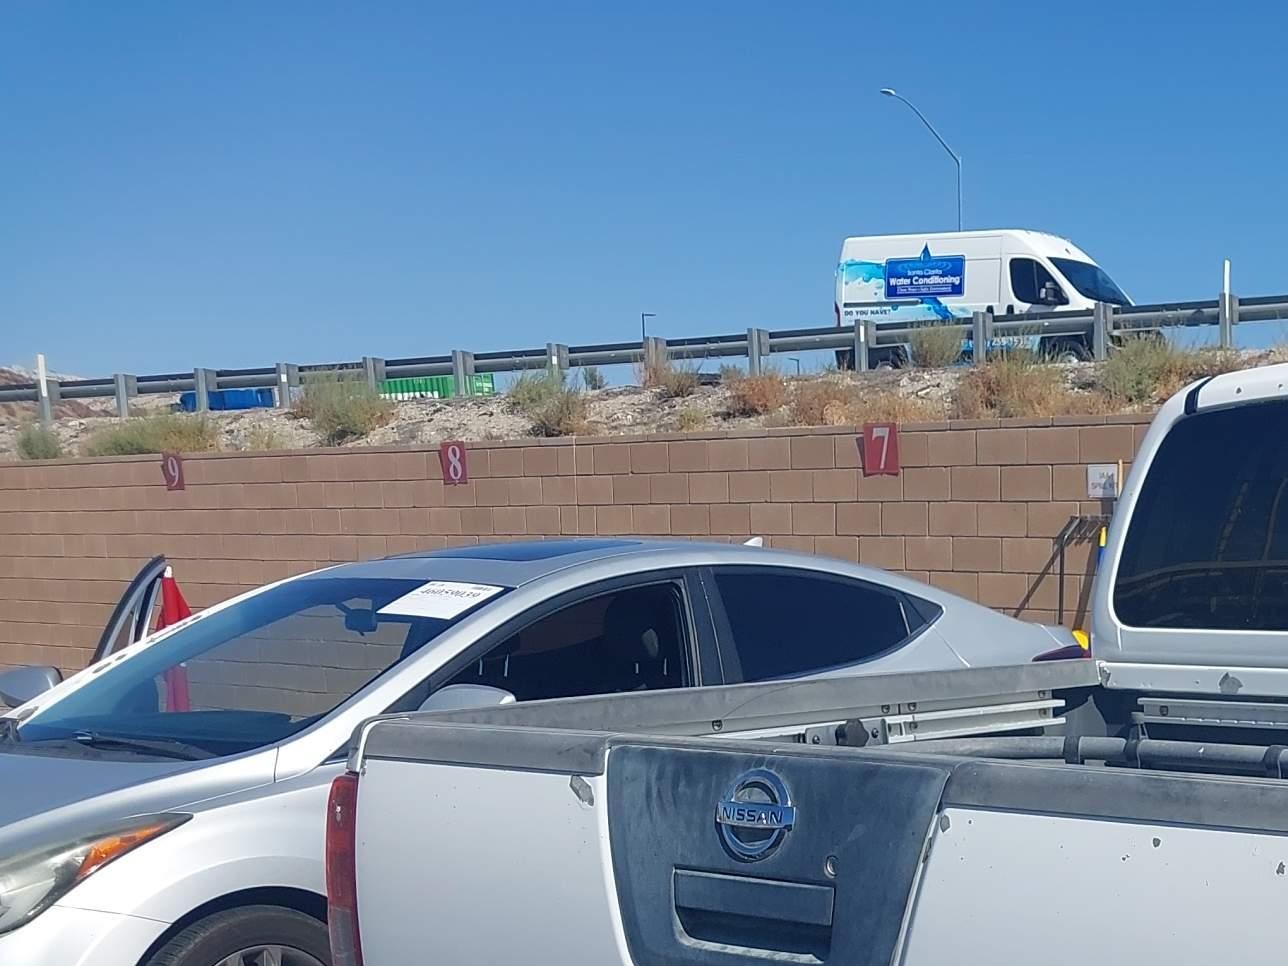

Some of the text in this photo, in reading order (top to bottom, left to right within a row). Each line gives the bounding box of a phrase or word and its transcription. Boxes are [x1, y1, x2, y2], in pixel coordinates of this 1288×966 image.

[889, 274, 961, 286] Water Conditioning
[447, 445, 462, 480] 8
[872, 426, 890, 469] 7
[167, 456, 179, 487] 9
[722, 806, 784, 825] NISSAN
